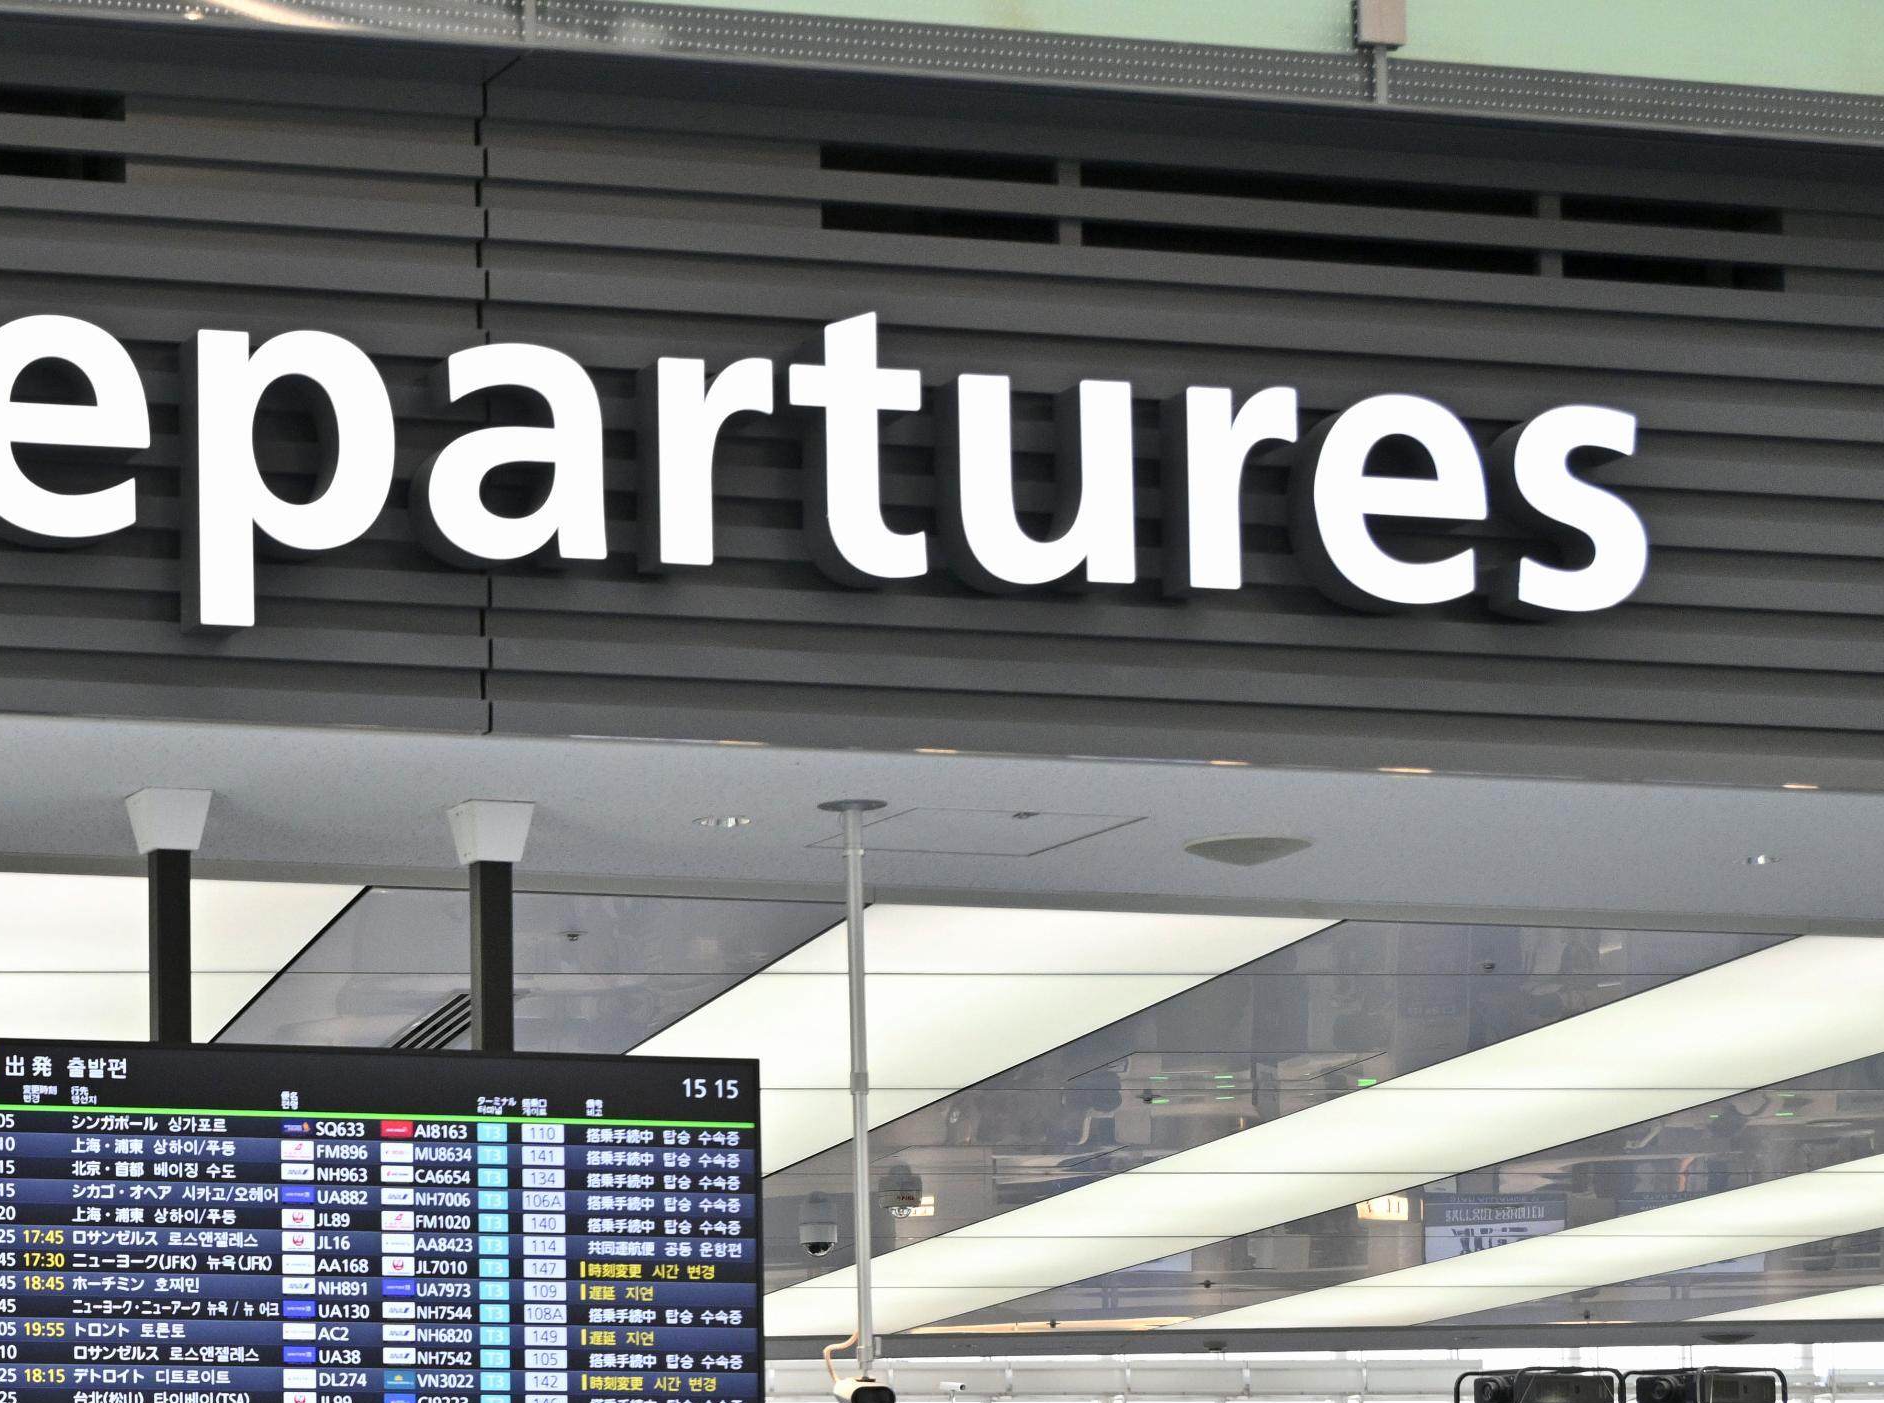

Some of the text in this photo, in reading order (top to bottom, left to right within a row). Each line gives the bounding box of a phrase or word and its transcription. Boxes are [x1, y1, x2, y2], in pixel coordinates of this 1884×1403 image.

[5, 1054, 52, 1077] 出発
[66, 1056, 127, 1080] 출발편
[682, 1078, 739, 1099] 15 15
[71, 1112, 158, 1131] シンガポール
[315, 1117, 365, 1137] SQ633
[316, 1144, 368, 1160] FM896
[316, 1189, 562, 1208] UA882 106A
[23, 1229, 64, 1245] 17:45
[72, 1229, 159, 1246] ロサンゼルス
[415, 1237, 473, 1253] AA8423
[317, 1258, 556, 1275] AA168 147
[72, 1275, 145, 1292] ホーチミン
[24, 1321, 65, 1337] 19:55
[75, 1321, 130, 1338] トロント
[140, 1322, 186, 1339] 토론토
[318, 1349, 472, 1366] UA38 NH7542
[24, 1367, 66, 1383] 18:15
[73, 1368, 145, 1384] デトロイト
[314, 1372, 367, 1387] DL274
